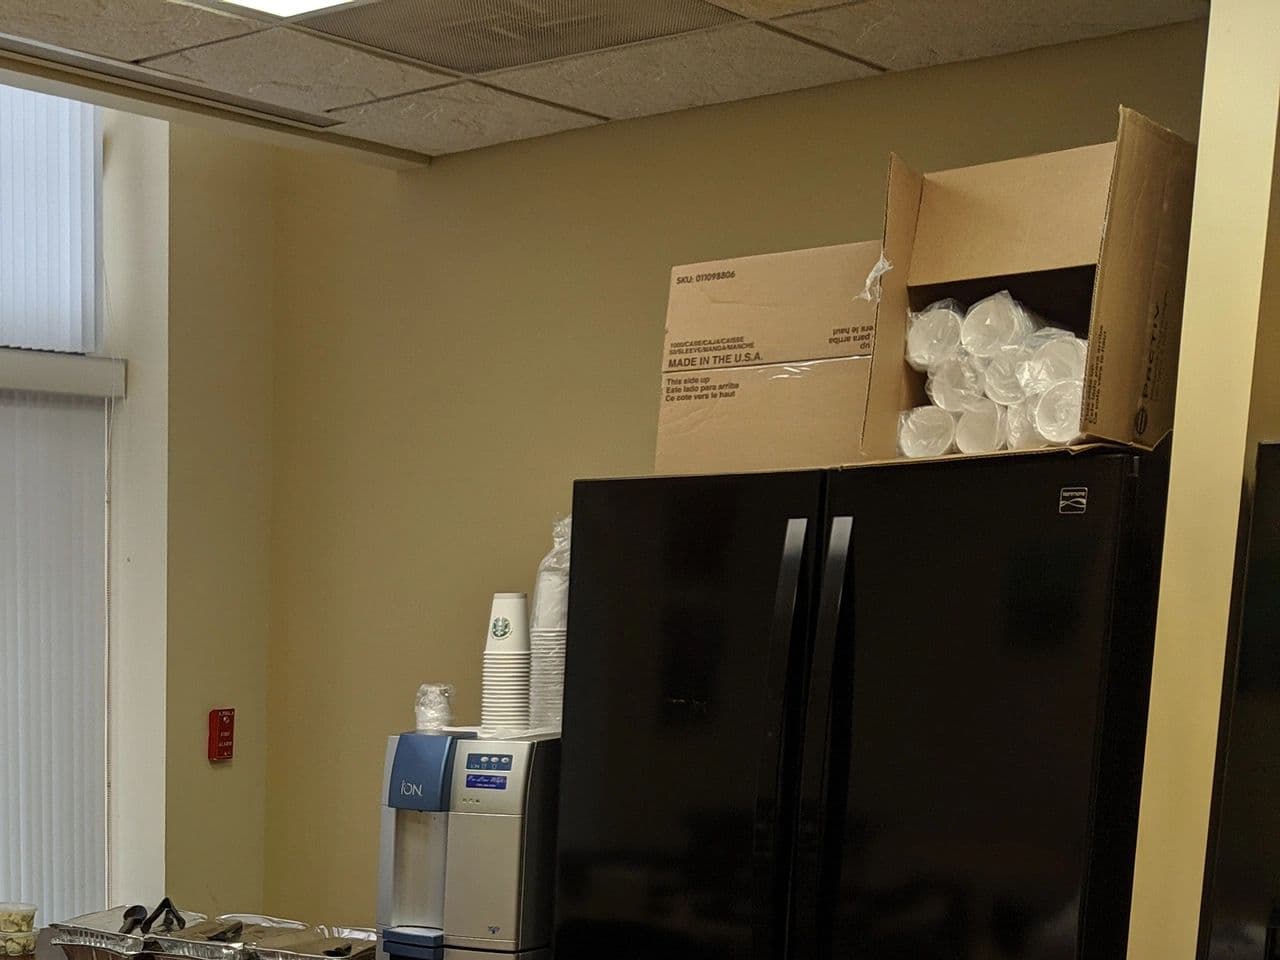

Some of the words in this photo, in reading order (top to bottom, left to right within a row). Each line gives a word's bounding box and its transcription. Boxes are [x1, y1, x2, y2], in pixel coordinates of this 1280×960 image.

[668, 357, 697, 368] MADE
[700, 355, 710, 365] IN
[712, 354, 732, 365] THE
[734, 351, 763, 362] U.S.A.
[667, 378, 682, 386] This
[683, 377, 699, 385] side
[700, 376, 710, 385] up
[666, 386, 682, 394] Este
[683, 385, 699, 393] lado
[700, 384, 717, 393] para
[718, 382, 739, 390] arriba
[665, 394, 675, 402] Ce
[718, 391, 736, 399] haut
